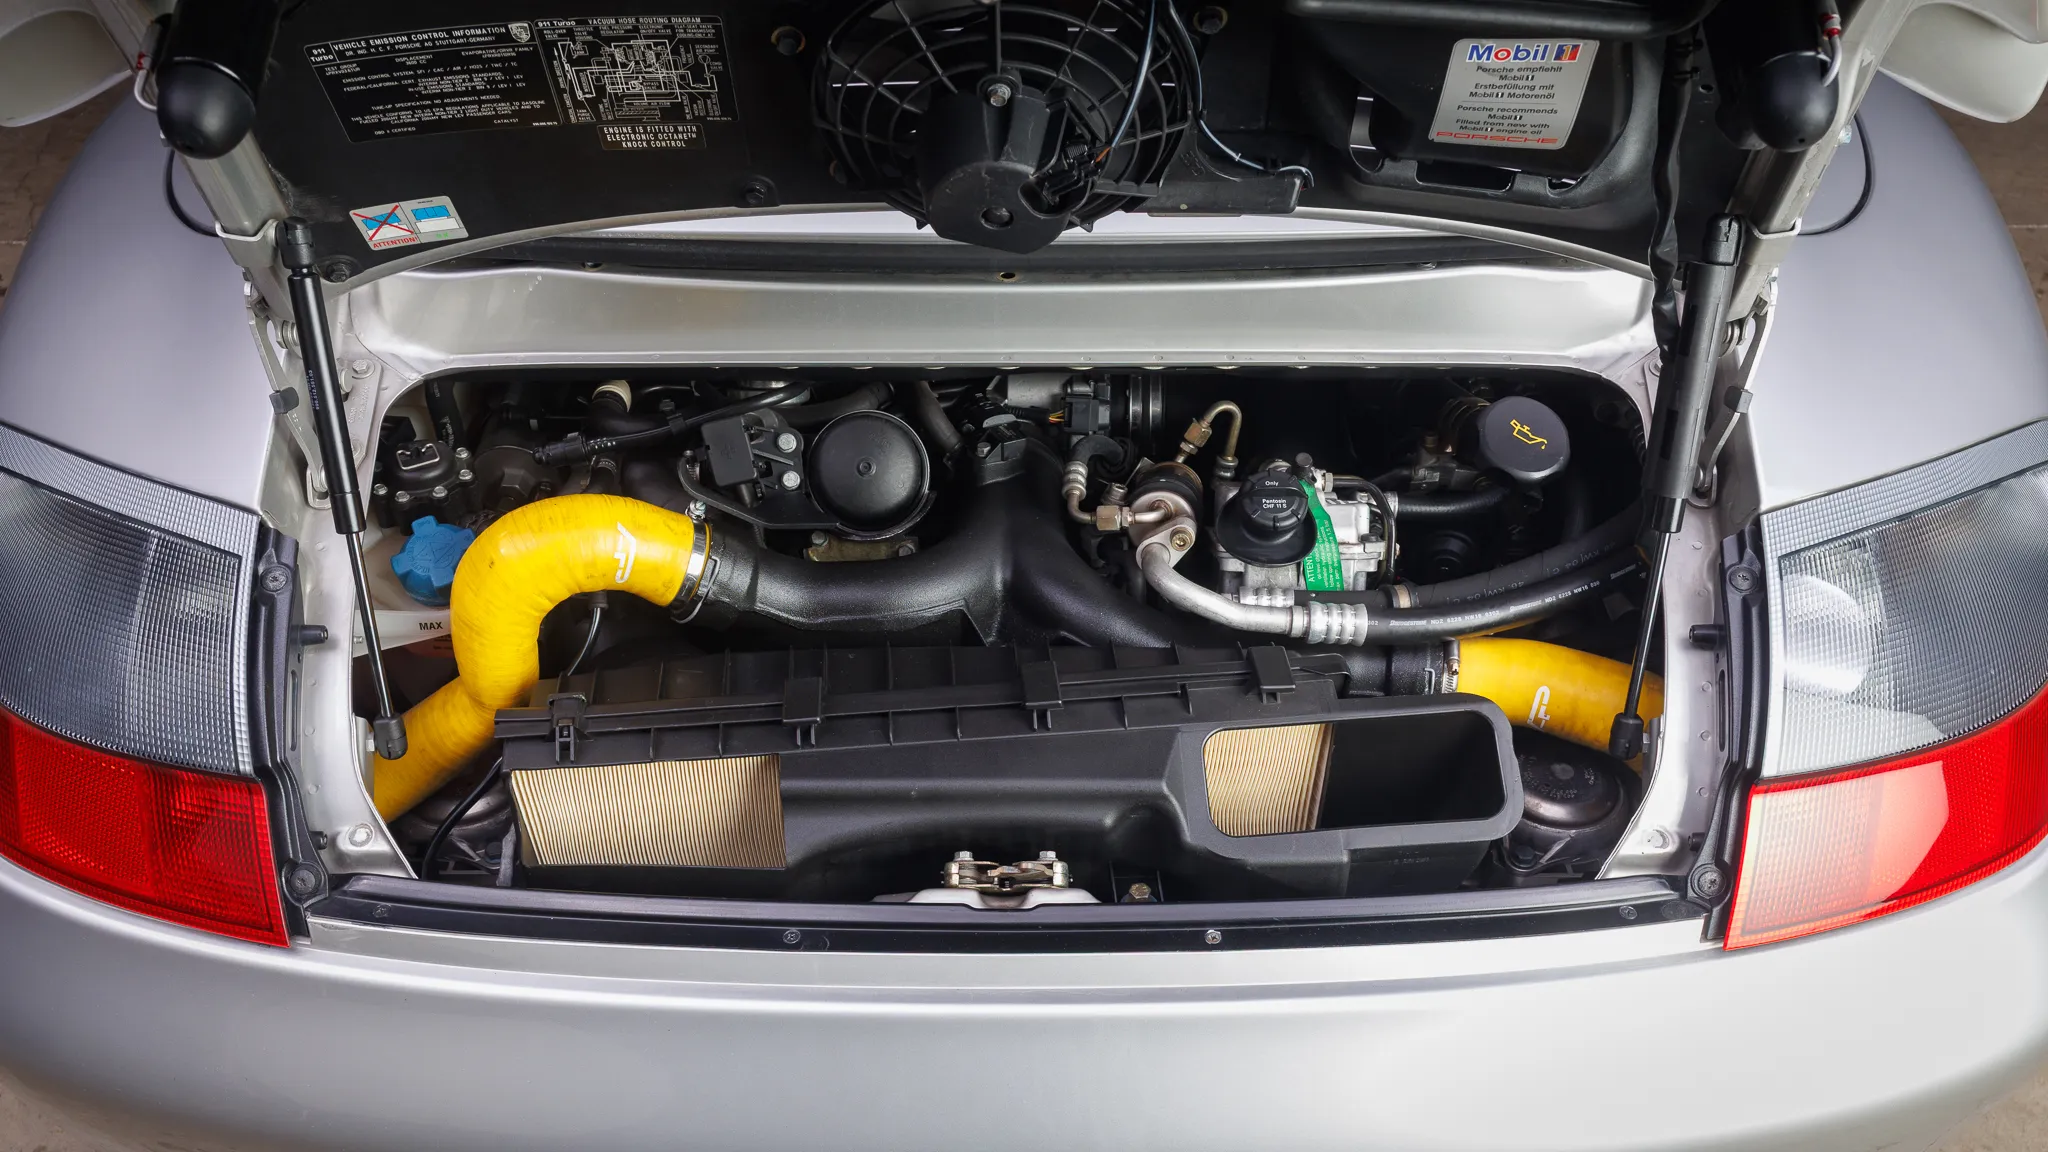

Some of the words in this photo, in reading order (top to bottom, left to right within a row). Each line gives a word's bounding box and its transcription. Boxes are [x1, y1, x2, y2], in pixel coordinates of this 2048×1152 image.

[333, 41, 366, 50] VEHICLE
[370, 36, 408, 45] EMISSION
[412, 32, 449, 40] CONTROL
[452, 27, 505, 36] INFORMATION
[1467, 44, 1550, 62] Mobil
[1517, 66, 1562, 74] empfiehlt
[1474, 83, 1536, 91] Erstbefüllung
[1496, 106, 1558, 114] recommends
[1436, 132, 1558, 144] PORSCHE
[373, 236, 418, 248] ATTENTION!
[1306, 552, 1315, 582] ATTENT
[419, 622, 443, 630] MAX
